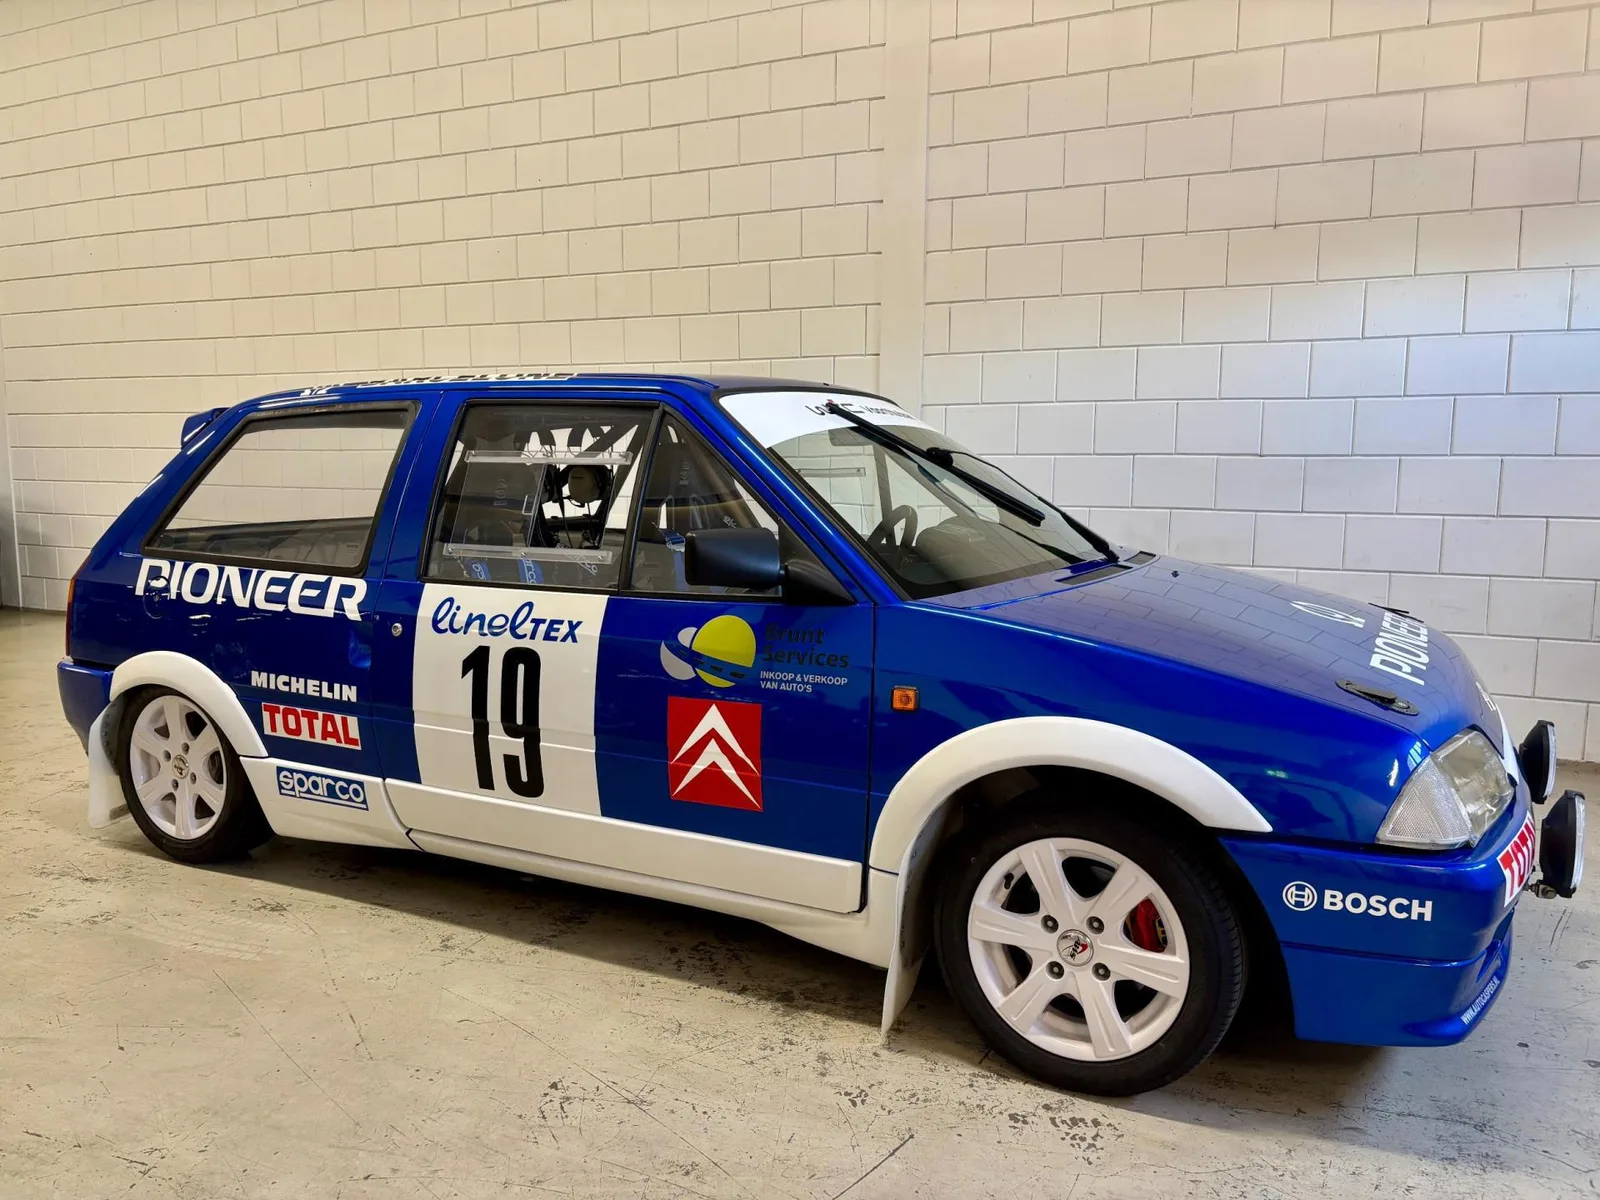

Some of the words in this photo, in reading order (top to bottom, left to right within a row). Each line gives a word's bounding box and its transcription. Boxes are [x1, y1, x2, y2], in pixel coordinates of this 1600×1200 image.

[135, 558, 368, 621] PIONEER
[765, 622, 825, 644] Brunt
[762, 644, 850, 668] Services
[251, 671, 358, 702] MICHELIN
[760, 671, 794, 681] INKOOP
[795, 674, 802, 682] &
[803, 674, 848, 686] VERKOOP
[760, 681, 778, 690] VAN
[780, 682, 813, 693] AUTO'S
[263, 703, 360, 747] TOTAL
[461, 645, 544, 798] 19
[279, 770, 364, 803] sparco
[1323, 889, 1433, 921] BOSCH
